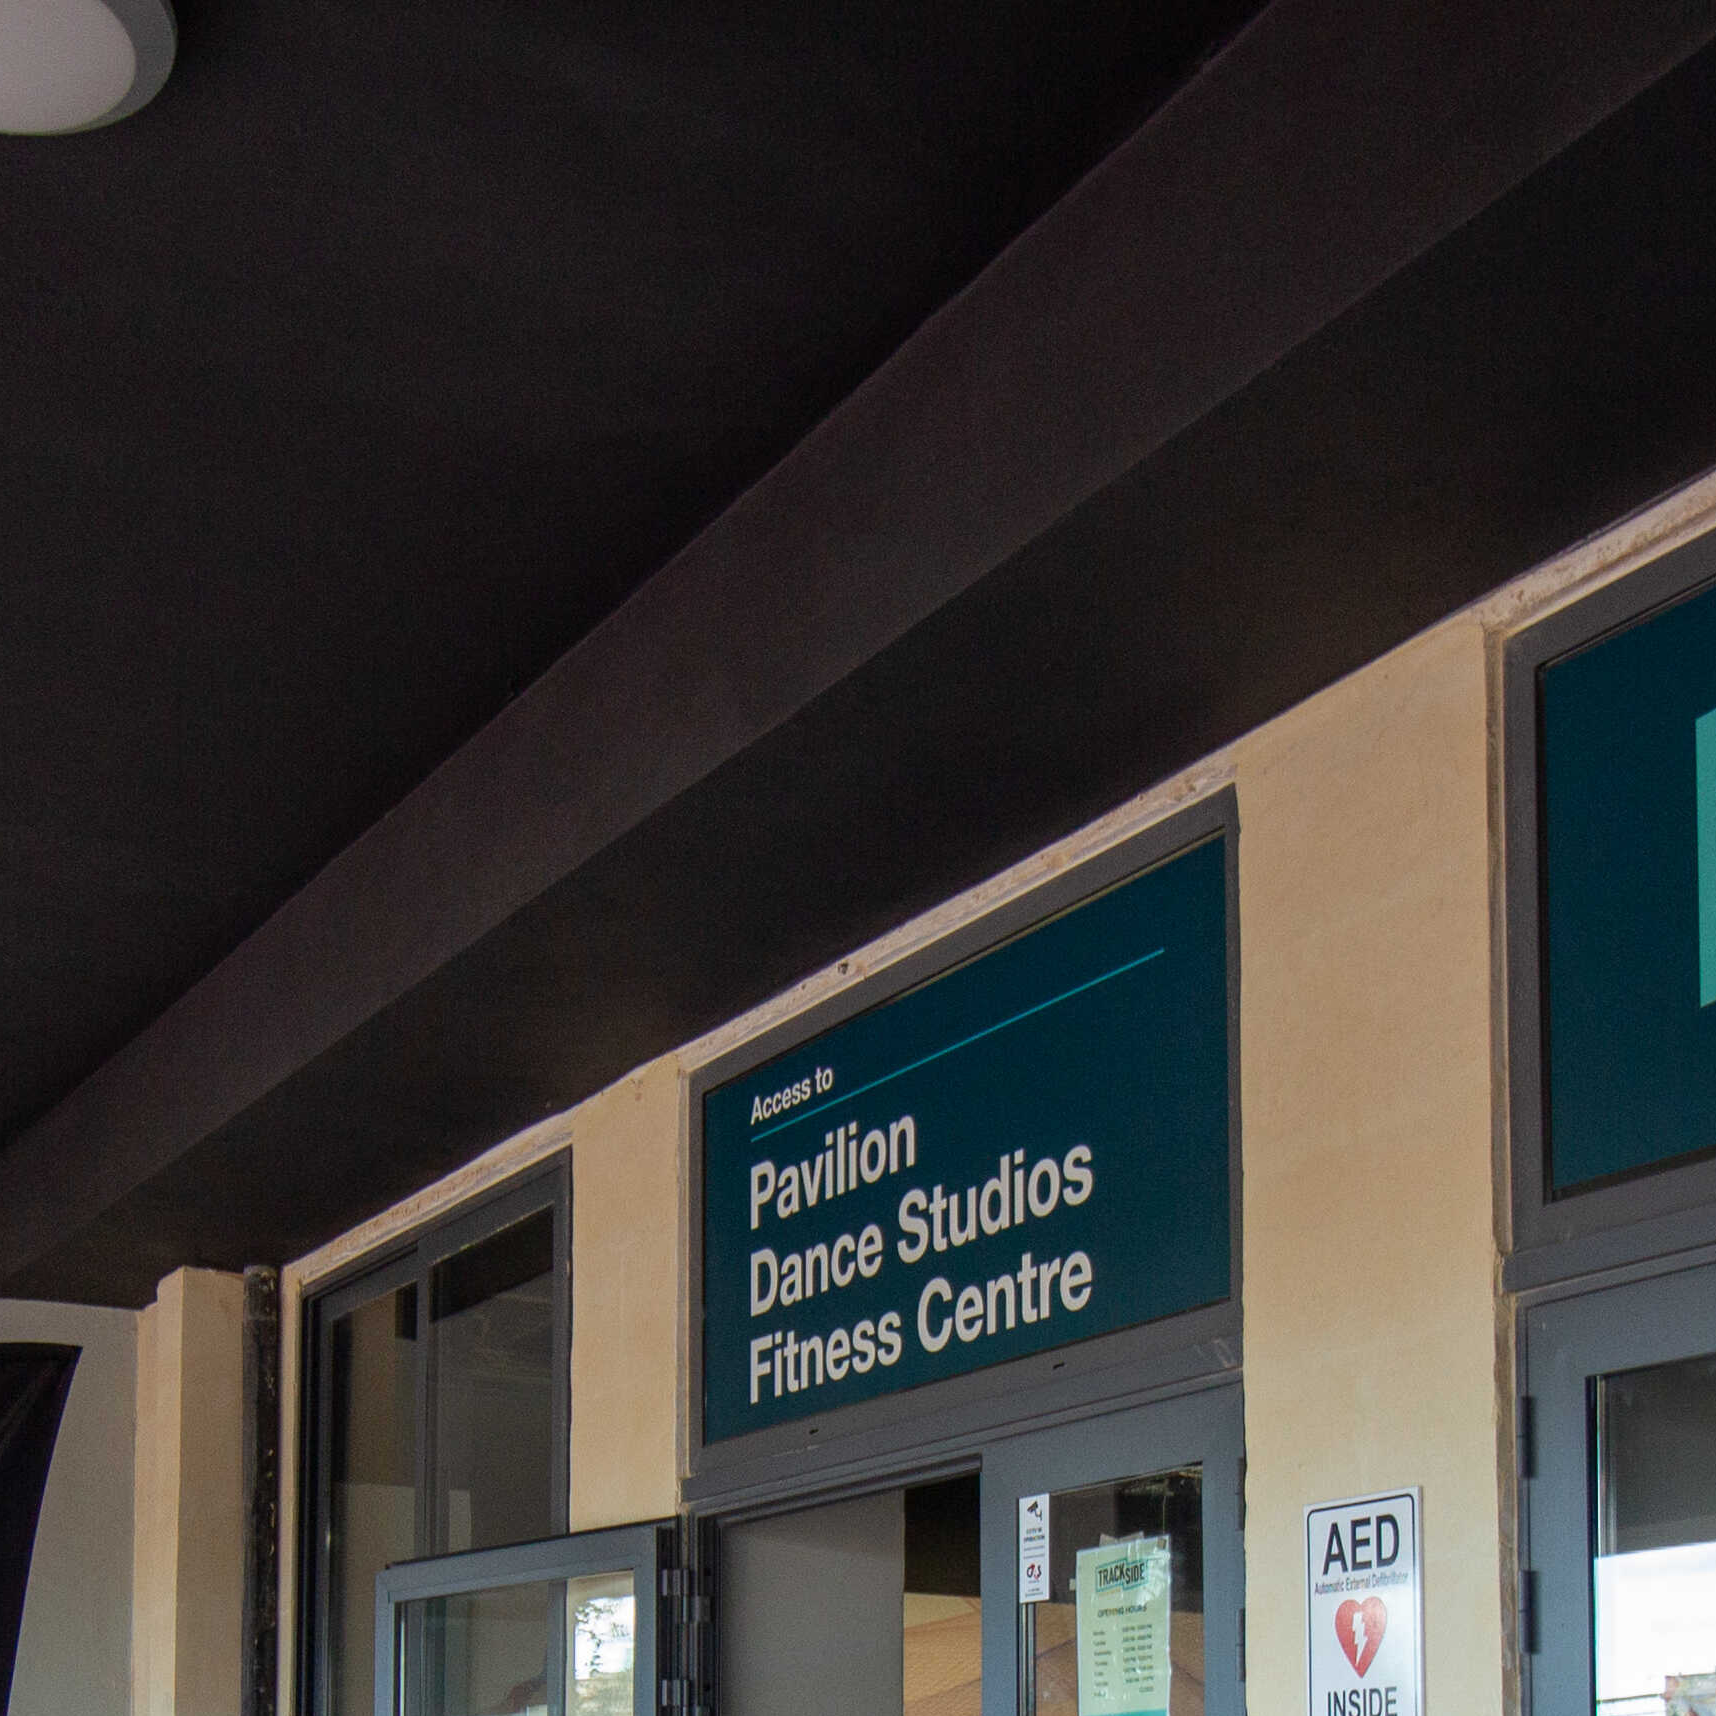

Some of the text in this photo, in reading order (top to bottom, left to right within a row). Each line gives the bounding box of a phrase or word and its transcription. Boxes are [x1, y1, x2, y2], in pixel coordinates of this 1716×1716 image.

[750, 1065, 834, 1125] Access to
[750, 1113, 916, 1230] Pavilion
[750, 1143, 1094, 1317] Dance Studios
[750, 1250, 1093, 1404] Fitness Centre
[1098, 1562, 1145, 1587] TRACKSIDE
[1322, 1513, 1400, 1576] AED
